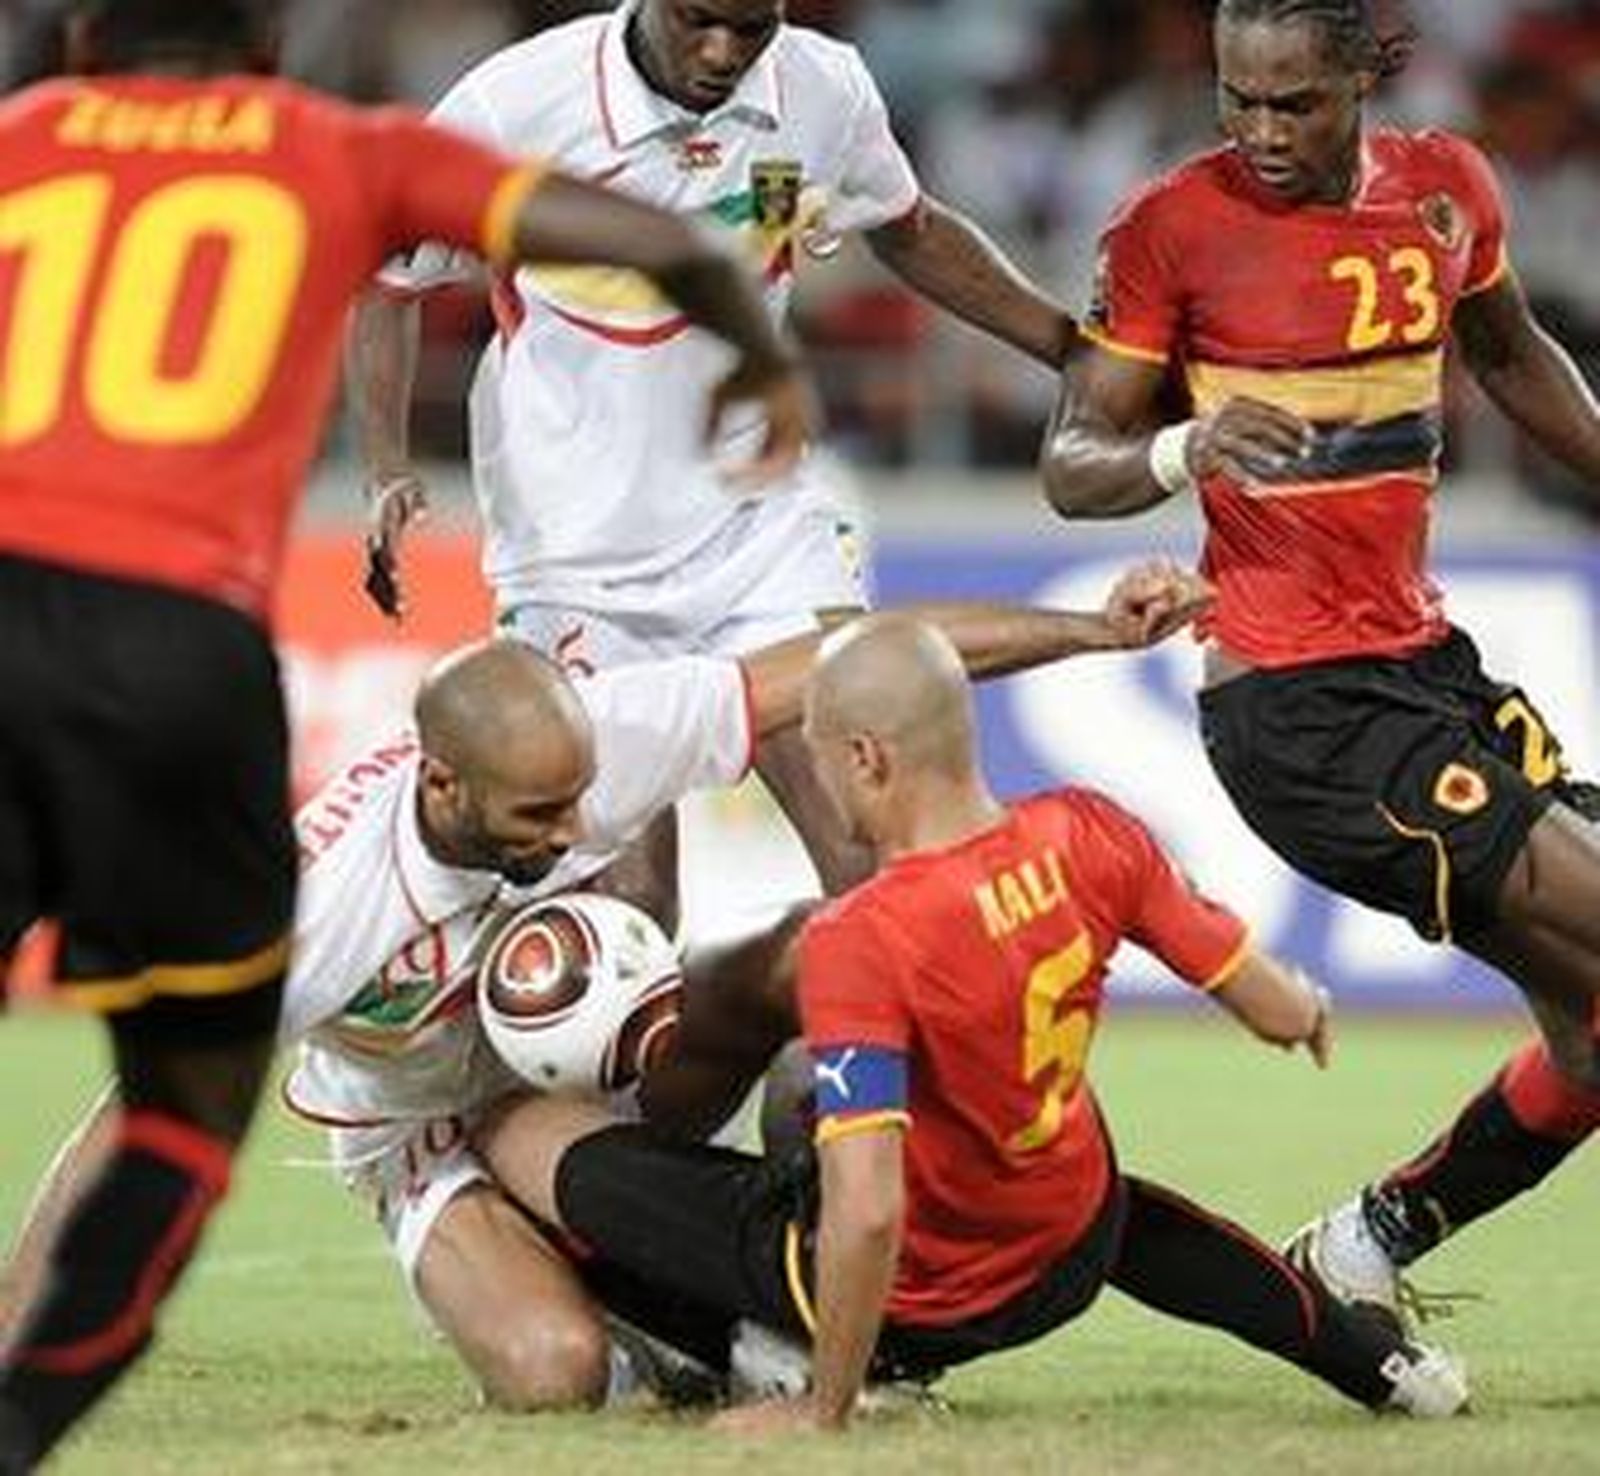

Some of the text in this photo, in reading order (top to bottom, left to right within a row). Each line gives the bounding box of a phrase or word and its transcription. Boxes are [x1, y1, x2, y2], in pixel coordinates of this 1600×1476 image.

[0, 170, 308, 445] 10
[1330, 247, 1440, 349] 23
[1494, 696, 1557, 788] 2
[975, 850, 1069, 938] KALI
[1012, 928, 1093, 1147] 5
